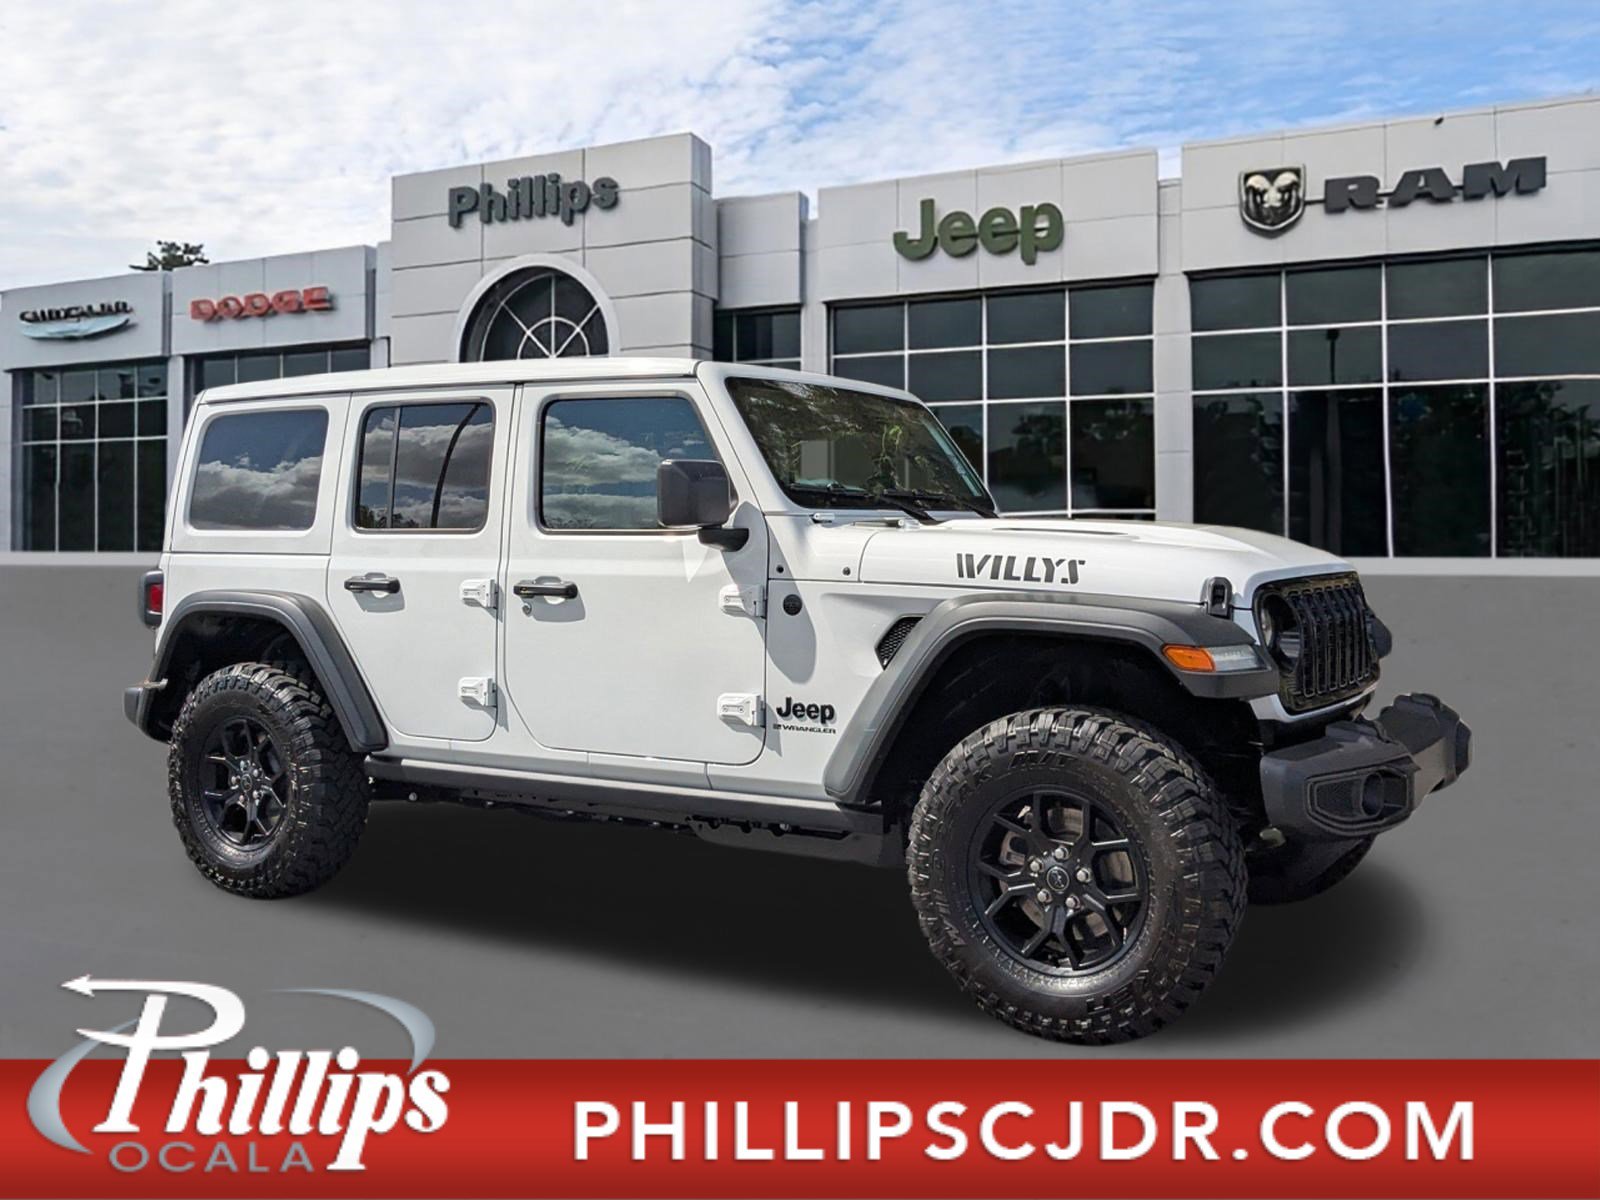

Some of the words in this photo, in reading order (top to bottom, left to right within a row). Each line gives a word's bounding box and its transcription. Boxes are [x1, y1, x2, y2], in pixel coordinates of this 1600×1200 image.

[448, 172, 620, 227] Phillips
[1323, 157, 1548, 213] RAM
[893, 198, 1064, 265] Jeep
[190, 286, 333, 322] DODGE
[956, 553, 1086, 584] WILLYS
[776, 696, 835, 725] Jeep
[782, 724, 837, 735] WRANGLER
